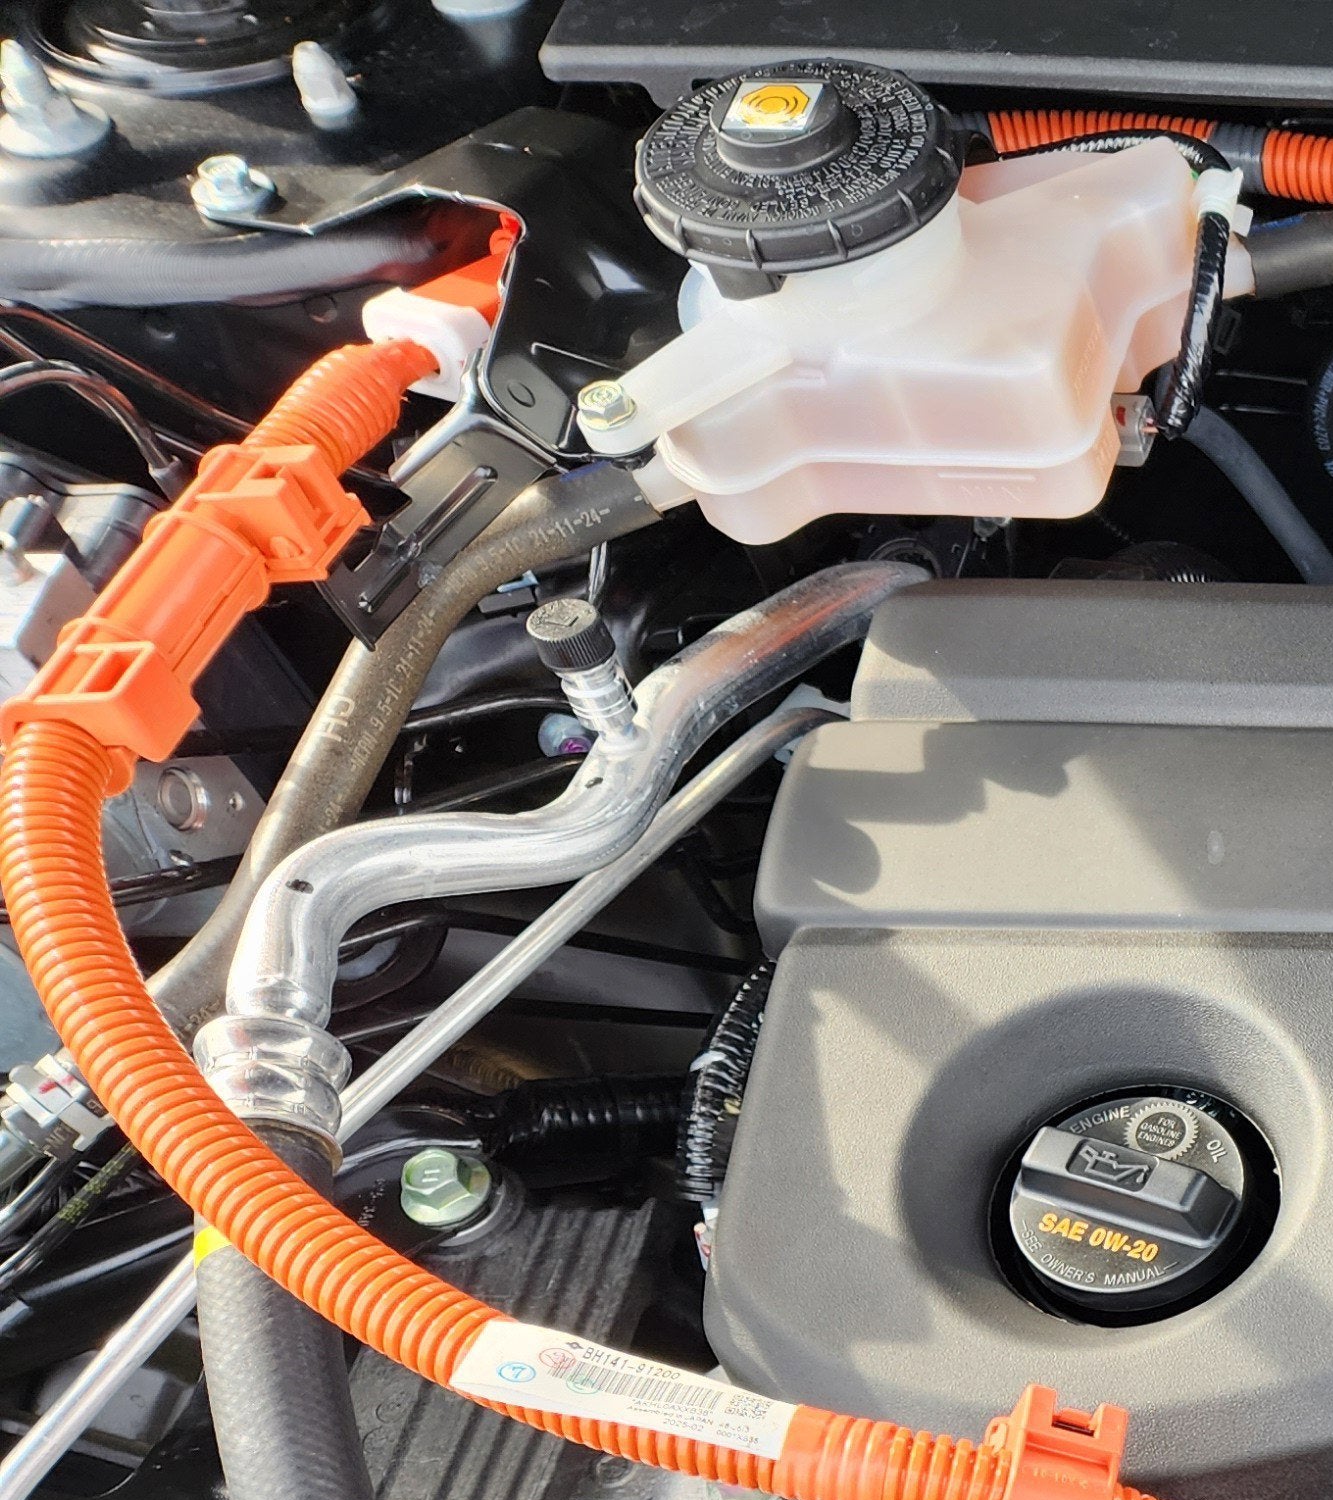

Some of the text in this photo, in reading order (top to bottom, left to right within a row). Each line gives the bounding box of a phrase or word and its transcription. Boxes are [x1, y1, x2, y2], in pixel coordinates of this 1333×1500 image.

[1070, 1105, 1228, 1163] ENGINE OIL
[1137, 1131, 1175, 1147] ENGINES
[1140, 1121, 1182, 1139] GASOLINE
[1157, 1116, 1176, 1130] FOR
[1038, 1213, 1159, 1263] SAE 0W-20
[1040, 1253, 1095, 1284] OWNER'S
[1104, 1264, 1165, 1286] MANUAL
[582, 1347, 681, 1381] BH141-91200
